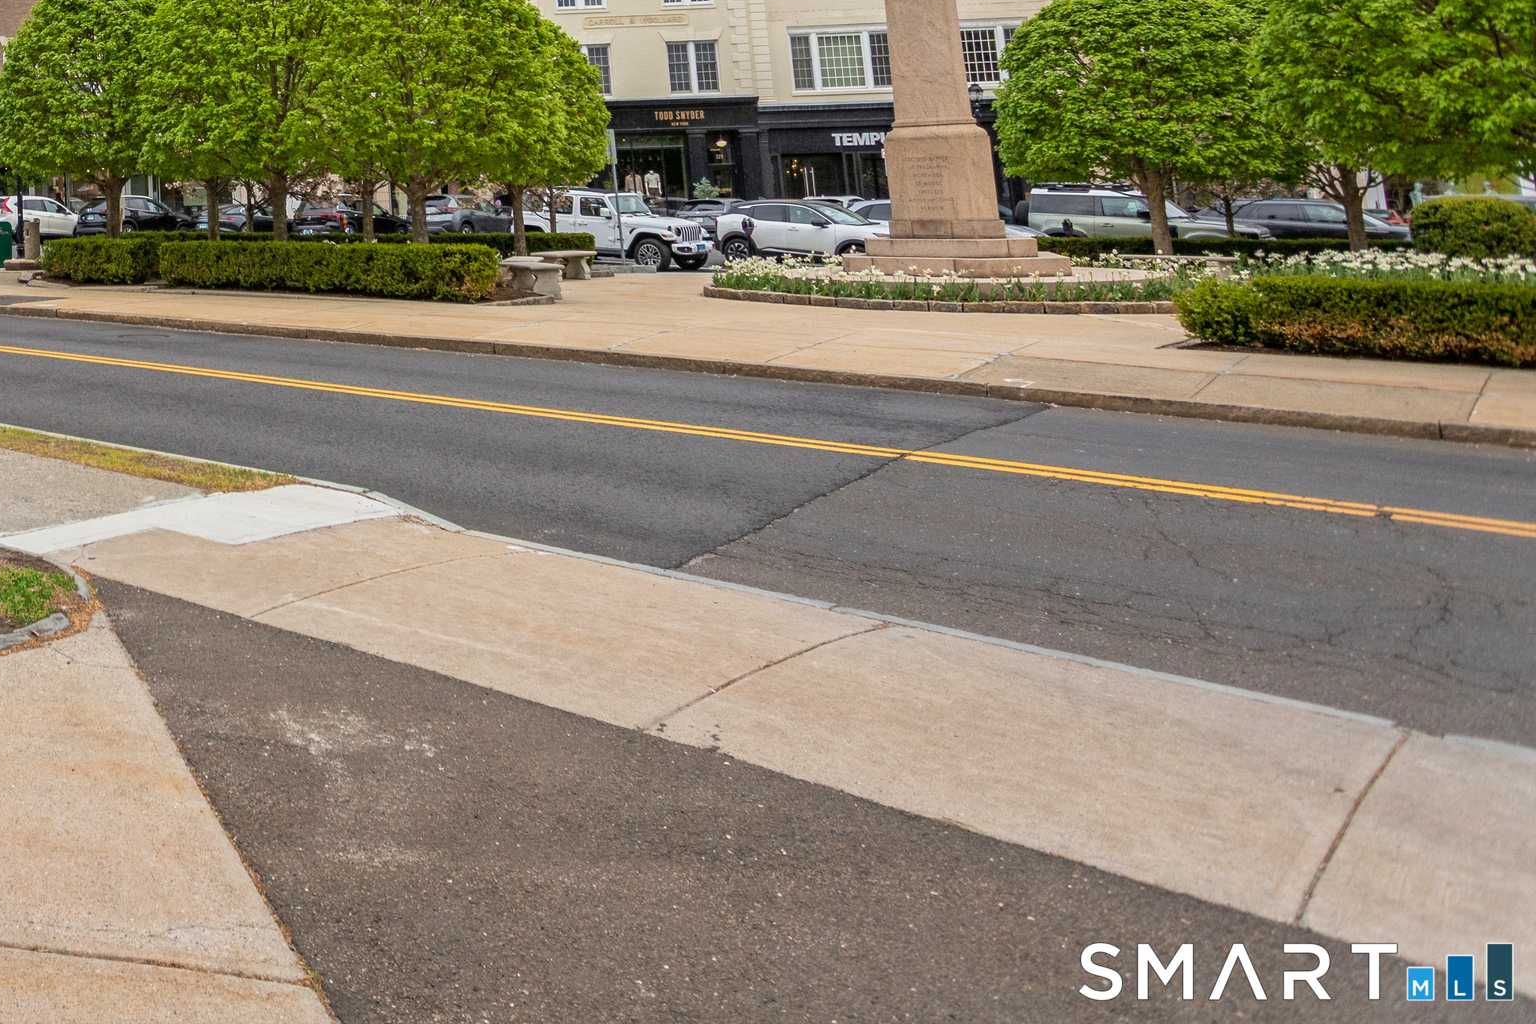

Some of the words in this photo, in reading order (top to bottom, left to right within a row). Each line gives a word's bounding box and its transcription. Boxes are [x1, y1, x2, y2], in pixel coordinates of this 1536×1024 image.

[588, 18, 624, 26] CARROLL
[654, 111, 674, 120] TODD
[675, 110, 705, 120] SNYDER
